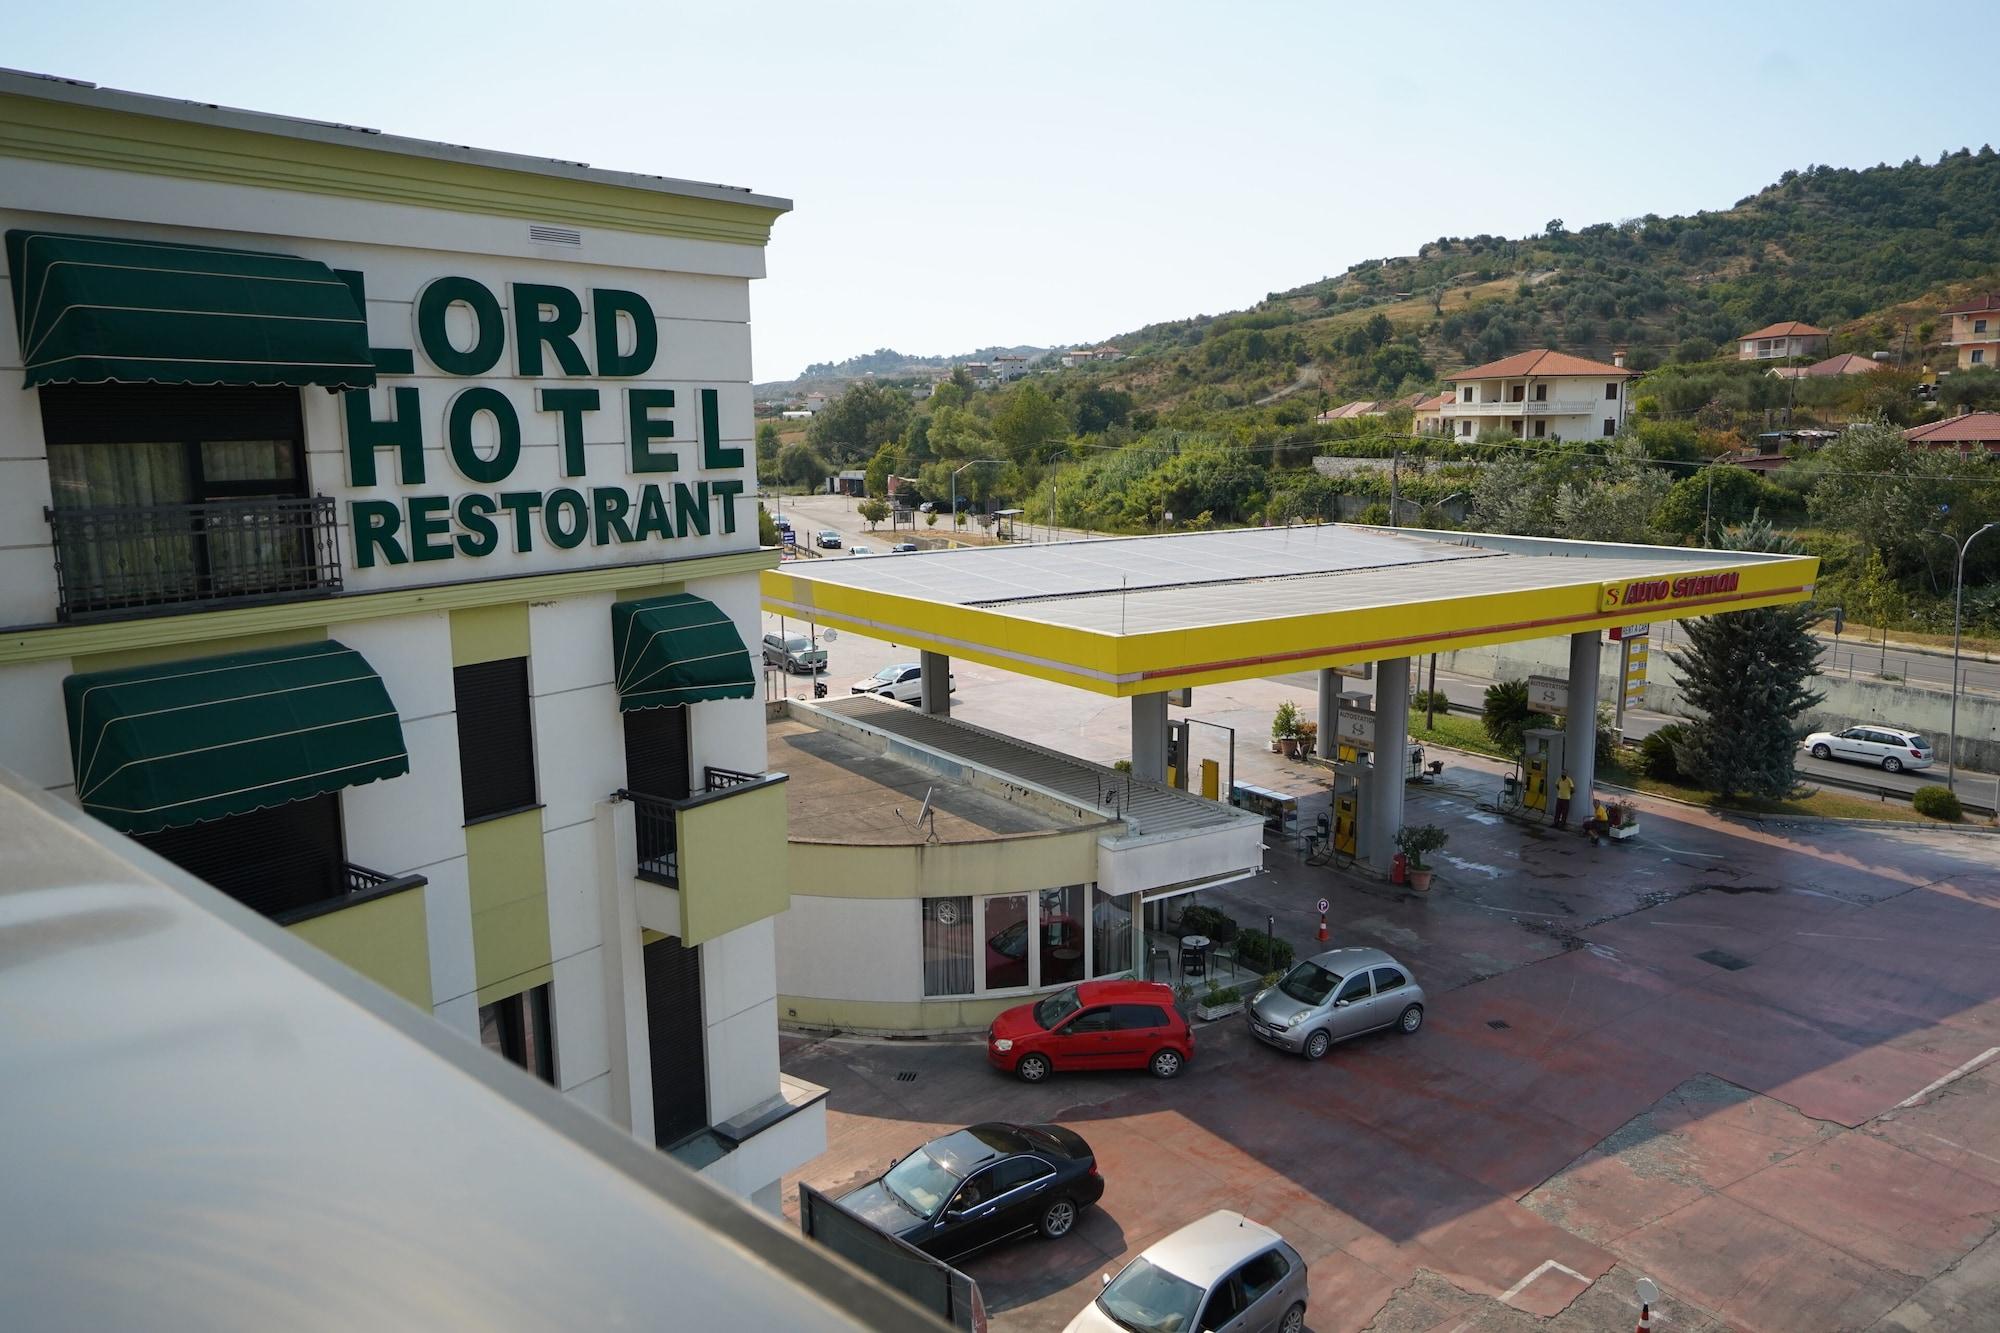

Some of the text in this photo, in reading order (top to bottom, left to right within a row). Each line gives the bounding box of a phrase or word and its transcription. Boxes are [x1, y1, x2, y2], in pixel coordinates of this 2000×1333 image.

[342, 387, 745, 487] HOTEL
[349, 480, 744, 569] RESTORANT
[1623, 580, 1669, 605] AUTO
[1671, 572, 1739, 599] STATION
